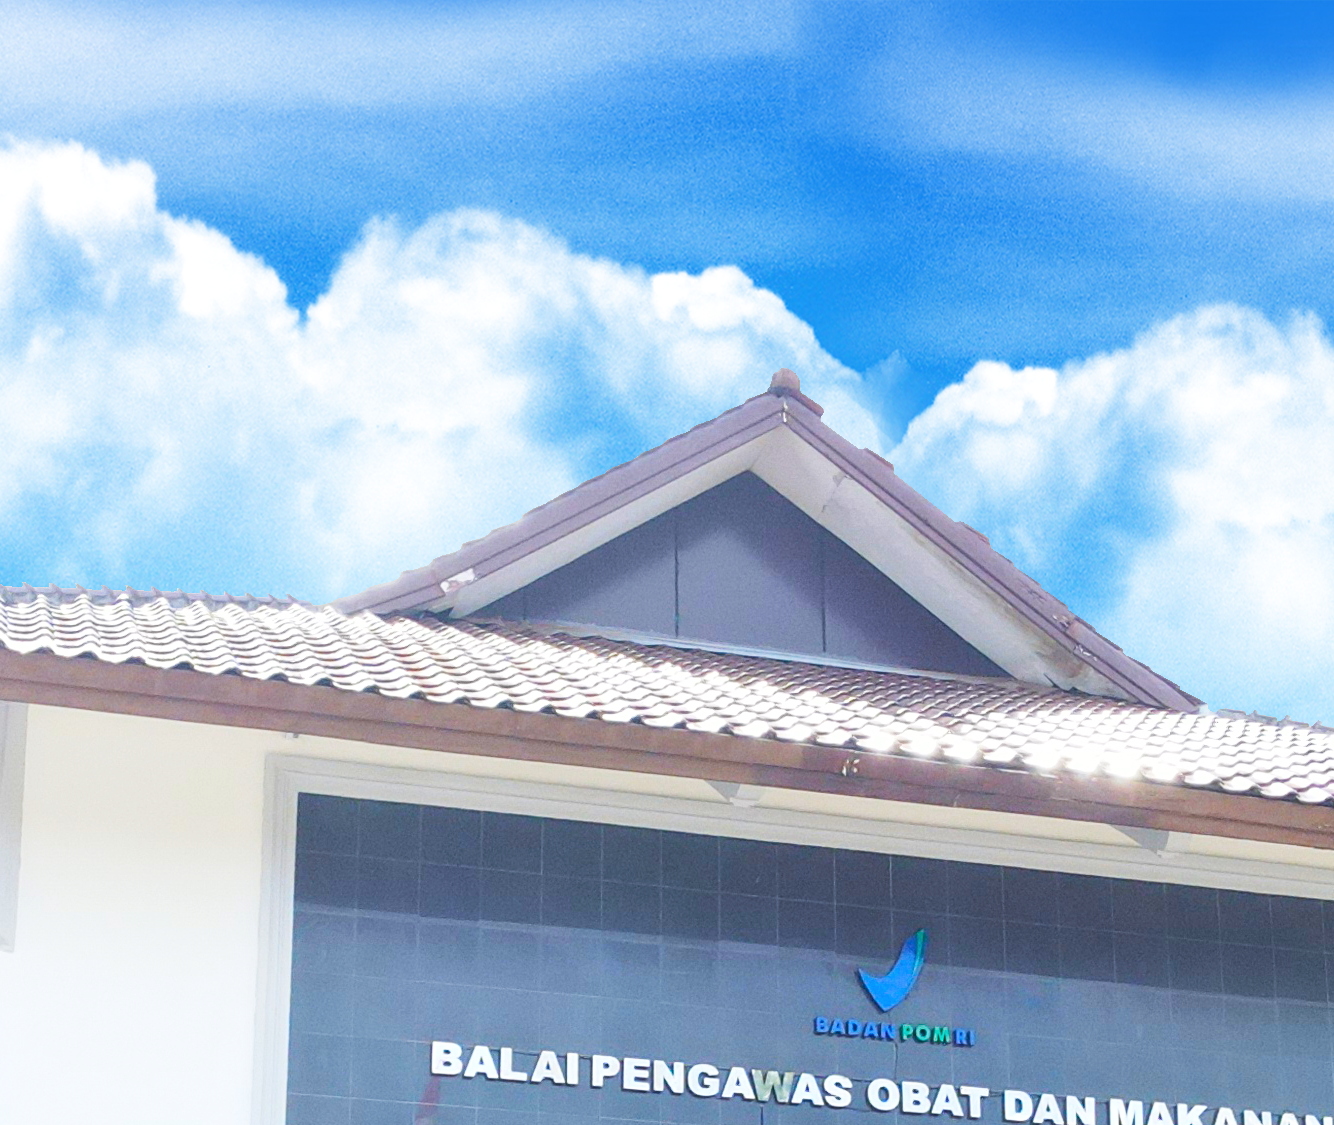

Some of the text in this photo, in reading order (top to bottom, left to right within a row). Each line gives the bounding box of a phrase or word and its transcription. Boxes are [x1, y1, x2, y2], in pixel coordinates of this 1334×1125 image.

[814, 1016, 976, 1046] BADAN POM RI
[431, 1040, 579, 1086] BALAI
[591, 1054, 854, 1108] PENGAWAS
[867, 1078, 990, 1119] OBAT
